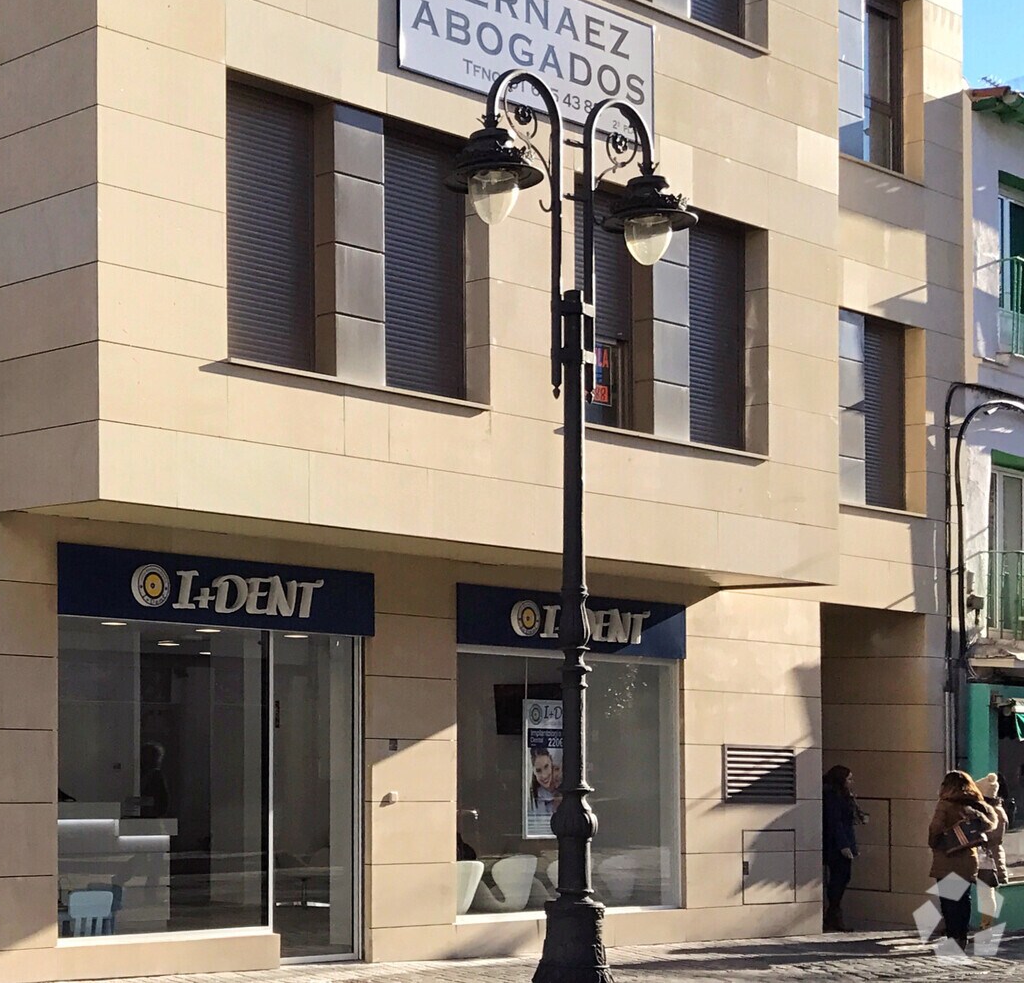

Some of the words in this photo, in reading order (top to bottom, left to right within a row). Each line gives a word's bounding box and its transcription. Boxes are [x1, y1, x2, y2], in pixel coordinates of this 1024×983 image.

[411, 0, 645, 105] ABOGADOS
[563, 93, 581, 111] 43
[172, 569, 325, 619] I+DENT
